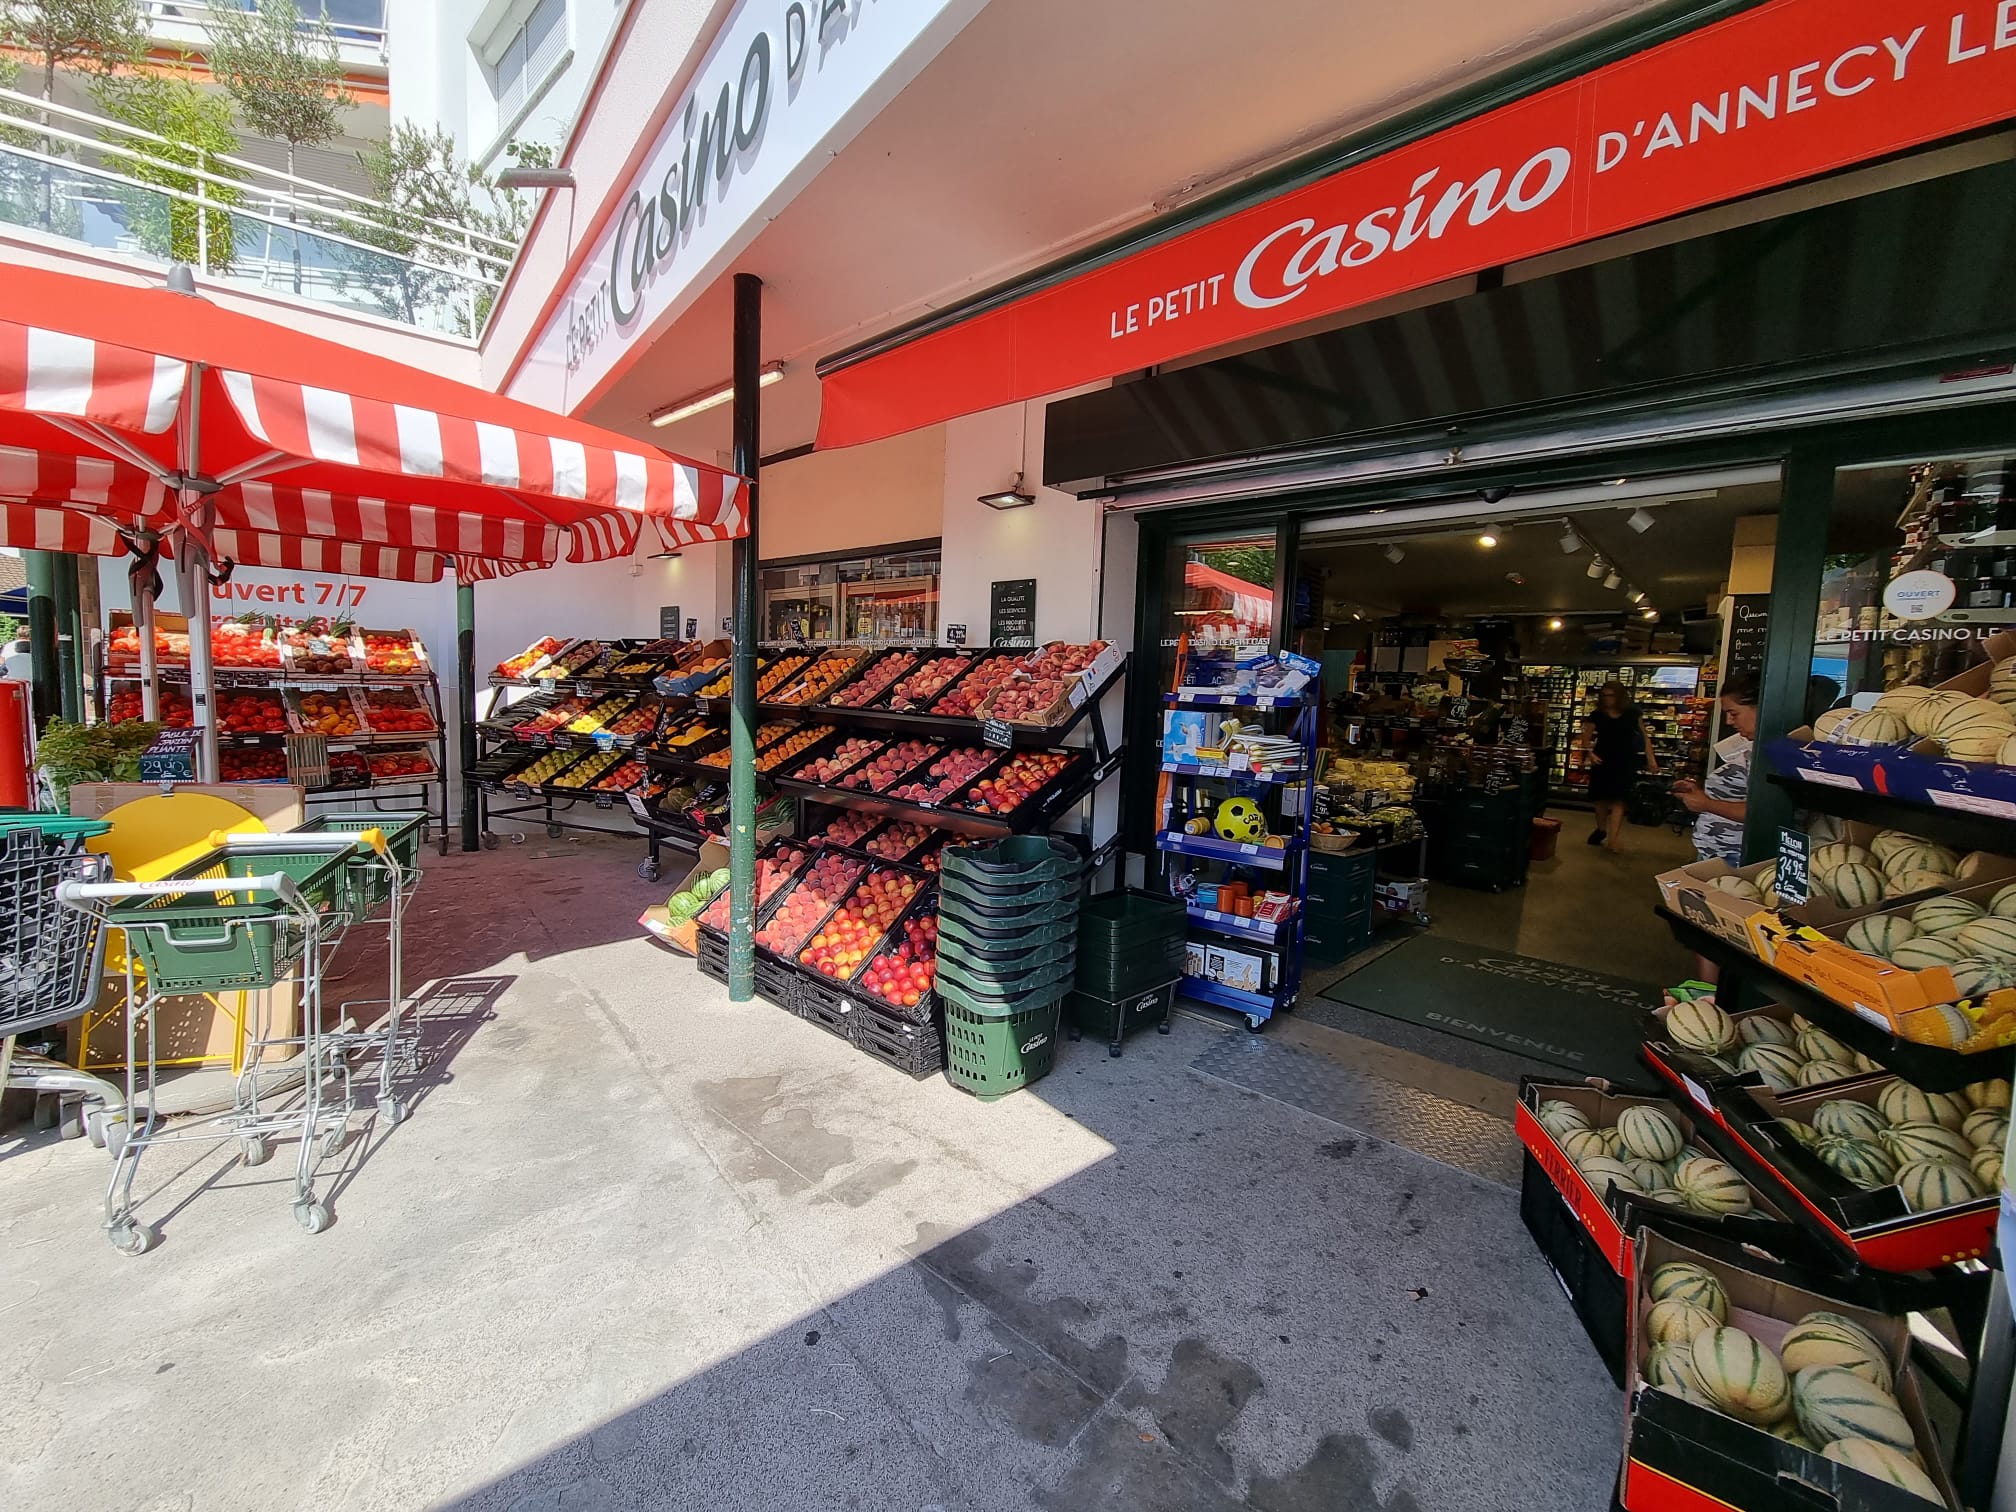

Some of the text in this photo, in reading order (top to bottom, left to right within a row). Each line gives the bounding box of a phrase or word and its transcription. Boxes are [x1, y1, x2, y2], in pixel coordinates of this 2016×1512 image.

[578, 279, 607, 354] PETIT
[609, 31, 771, 328] Casino
[1110, 304, 1140, 339] LE
[1148, 272, 1226, 328] PETIT
[1232, 146, 1572, 310] Casino
[1595, 25, 1928, 174] D'ANNECY
[211, 583, 367, 607] uvert 7/7
[1896, 590, 1941, 598] OUVERT
[1841, 629, 1891, 642] PETIT
[1892, 627, 1971, 642] CASINO
[159, 730, 190, 739] TABLE
[1424, 1011, 1585, 1062] BIENVENUE
[1544, 1149, 1582, 1212] FERRIER
